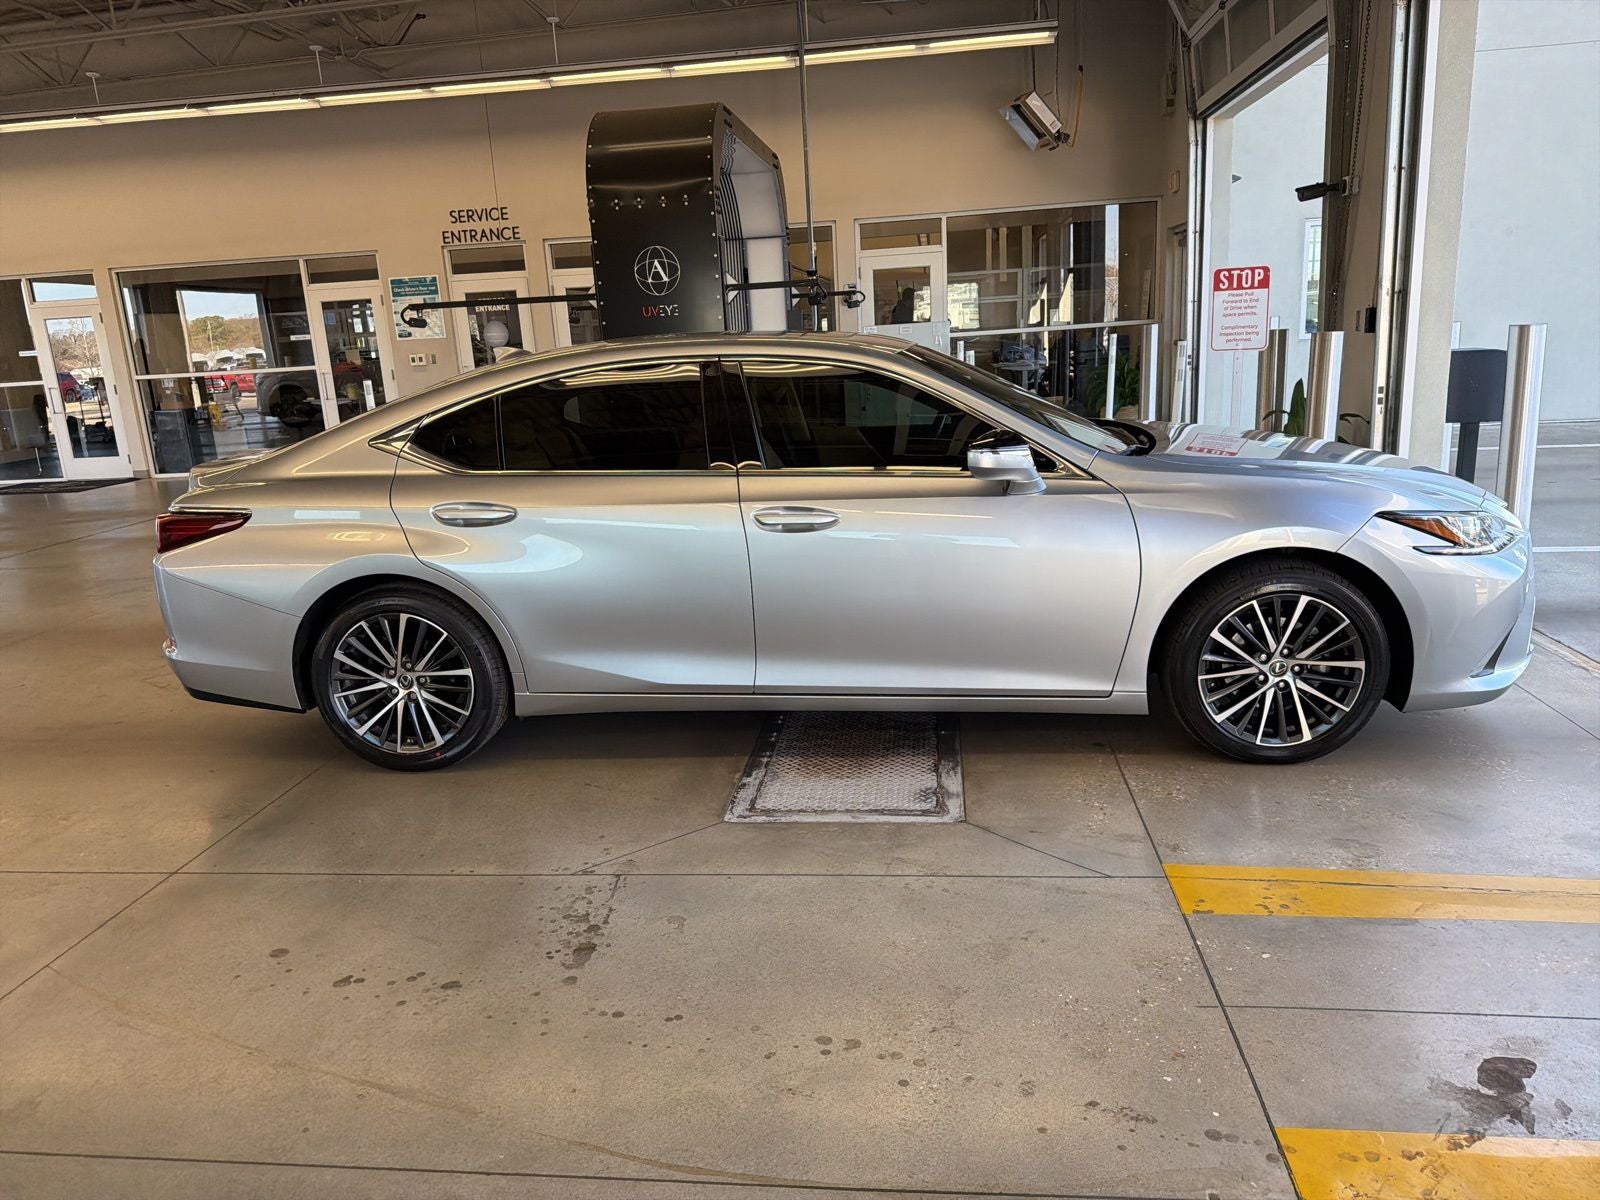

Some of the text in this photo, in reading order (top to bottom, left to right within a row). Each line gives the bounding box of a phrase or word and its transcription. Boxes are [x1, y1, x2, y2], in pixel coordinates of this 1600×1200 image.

[449, 206, 509, 224] SERVICE
[441, 226, 521, 245] ENTRANCE
[1220, 269, 1264, 289] STOP
[475, 304, 510, 312] ENTRANCE
